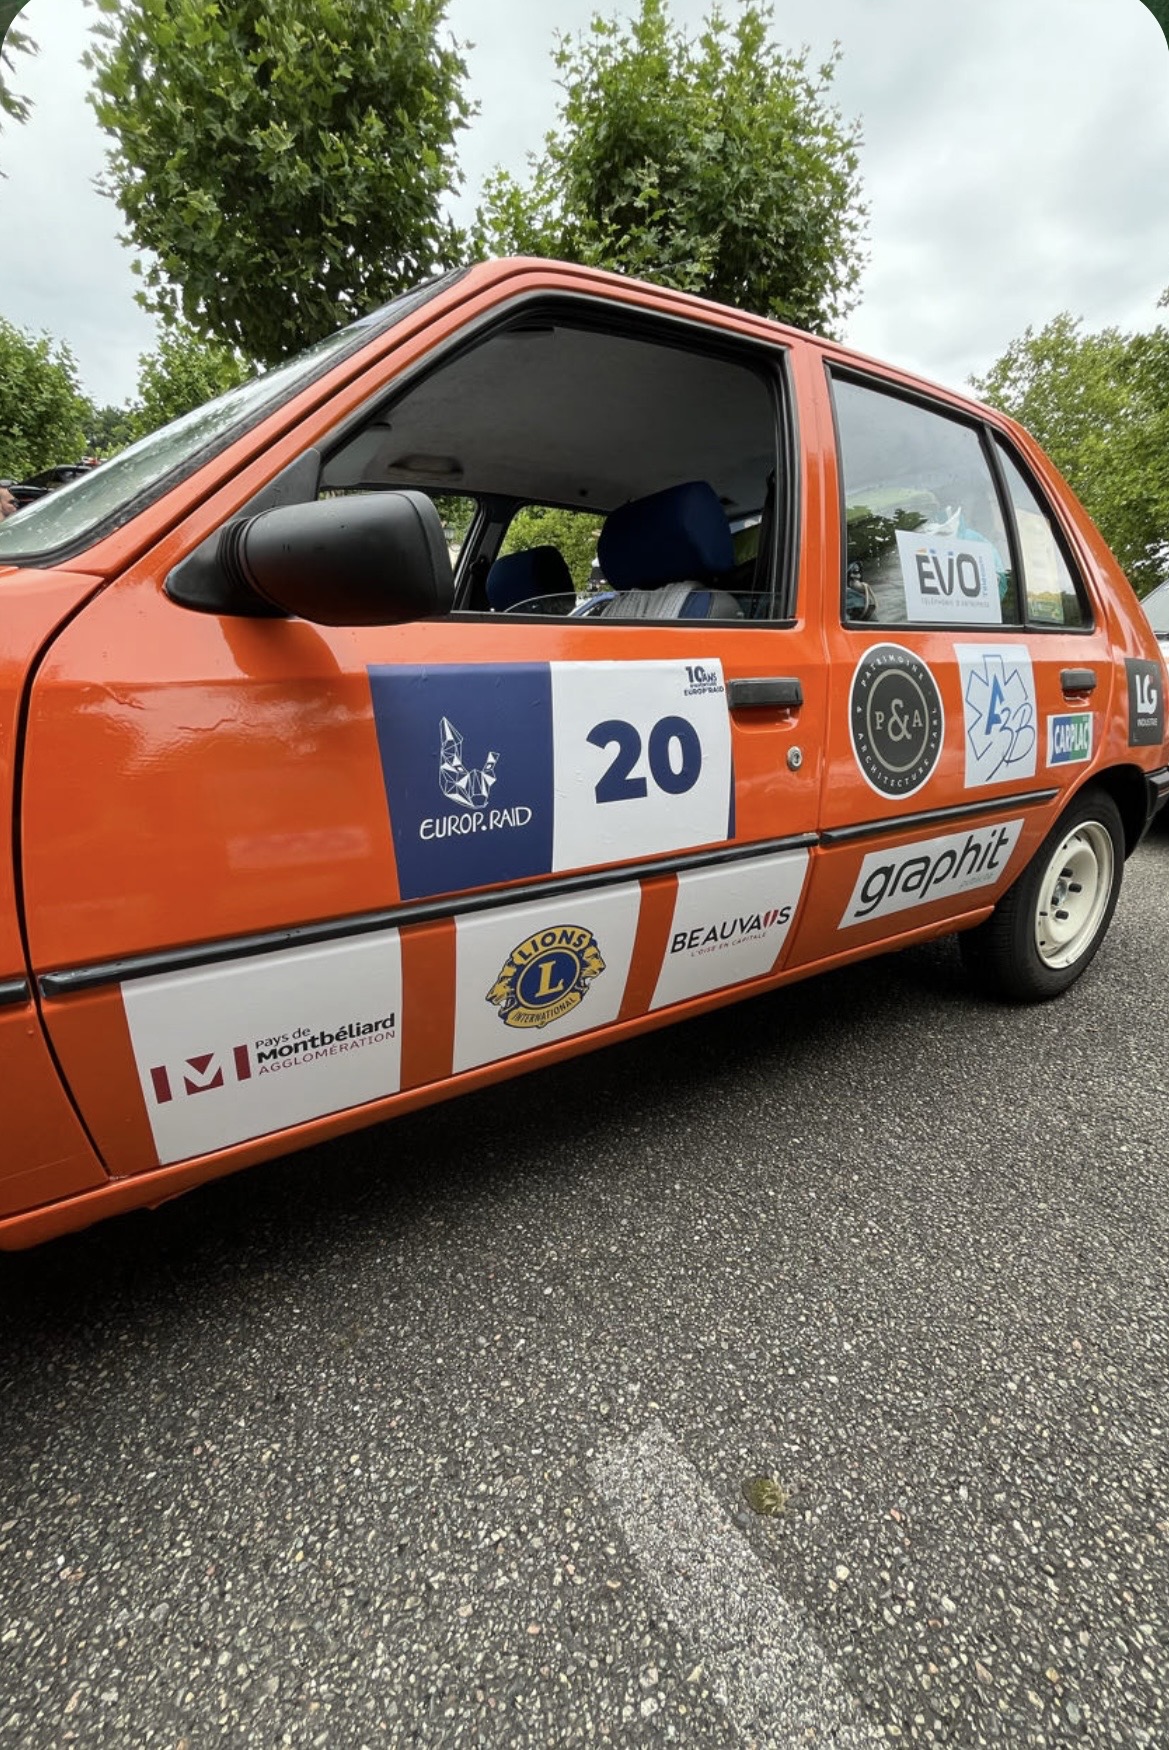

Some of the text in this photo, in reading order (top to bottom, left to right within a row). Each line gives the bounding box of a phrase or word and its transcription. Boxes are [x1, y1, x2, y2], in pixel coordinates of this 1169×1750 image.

[685, 665, 718, 683] 10 ANS
[860, 654, 924, 687] PATRIMOINE
[1135, 674, 1158, 714] LG
[586, 715, 702, 804] 20
[858, 732, 929, 788] ARCHITECTURE
[419, 806, 533, 840] EUROP.RAID
[853, 827, 1009, 918] graphit
[518, 929, 588, 961] LIONS
[535, 960, 565, 998] L
[513, 996, 576, 1024] INTERNATIONAL
[257, 1012, 396, 1065] Montbéliard
[291, 1027, 311, 1040] de
[258, 1030, 397, 1076] AGGLOMÉRATION
